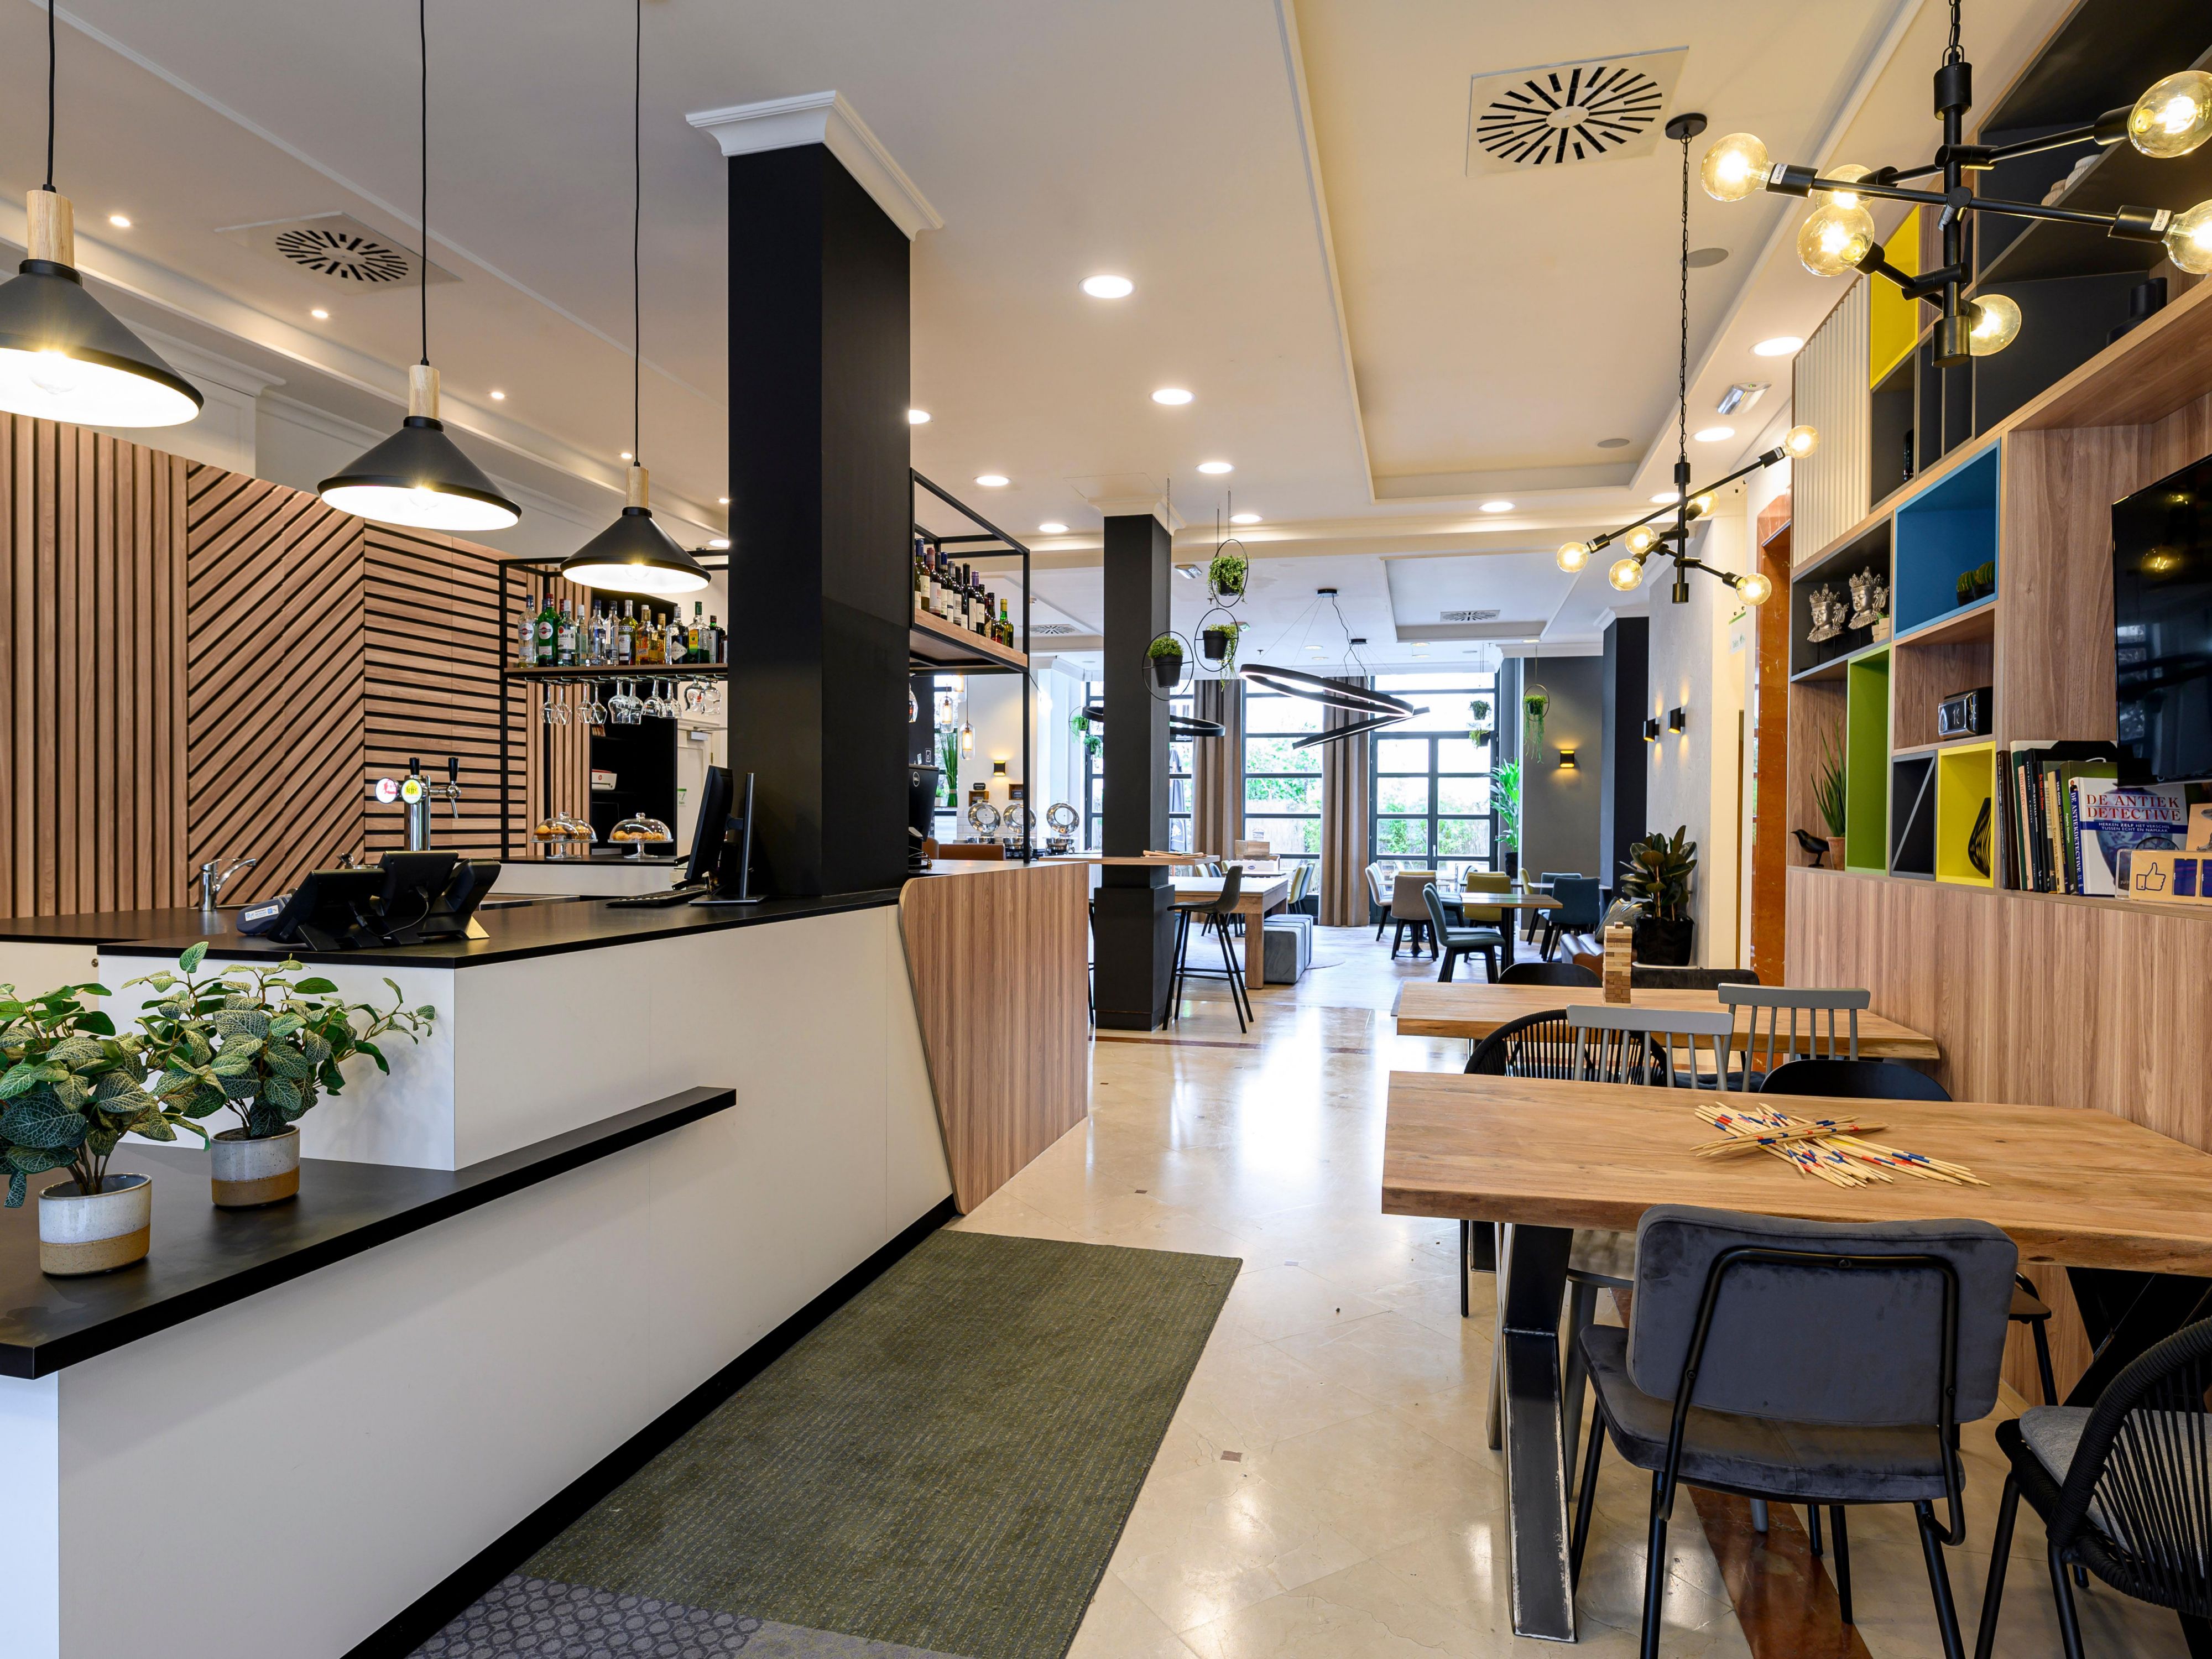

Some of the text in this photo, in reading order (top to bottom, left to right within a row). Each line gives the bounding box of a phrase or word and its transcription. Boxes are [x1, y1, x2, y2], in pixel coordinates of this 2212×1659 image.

[406, 786, 418, 795] Leffe
[2071, 792, 2076, 803] DE
[2086, 795, 2180, 808] DE ANTIEK
[2087, 807, 2181, 821] DETECTIVE
[2072, 804, 2081, 873] ANTIEKDETECTIVE
